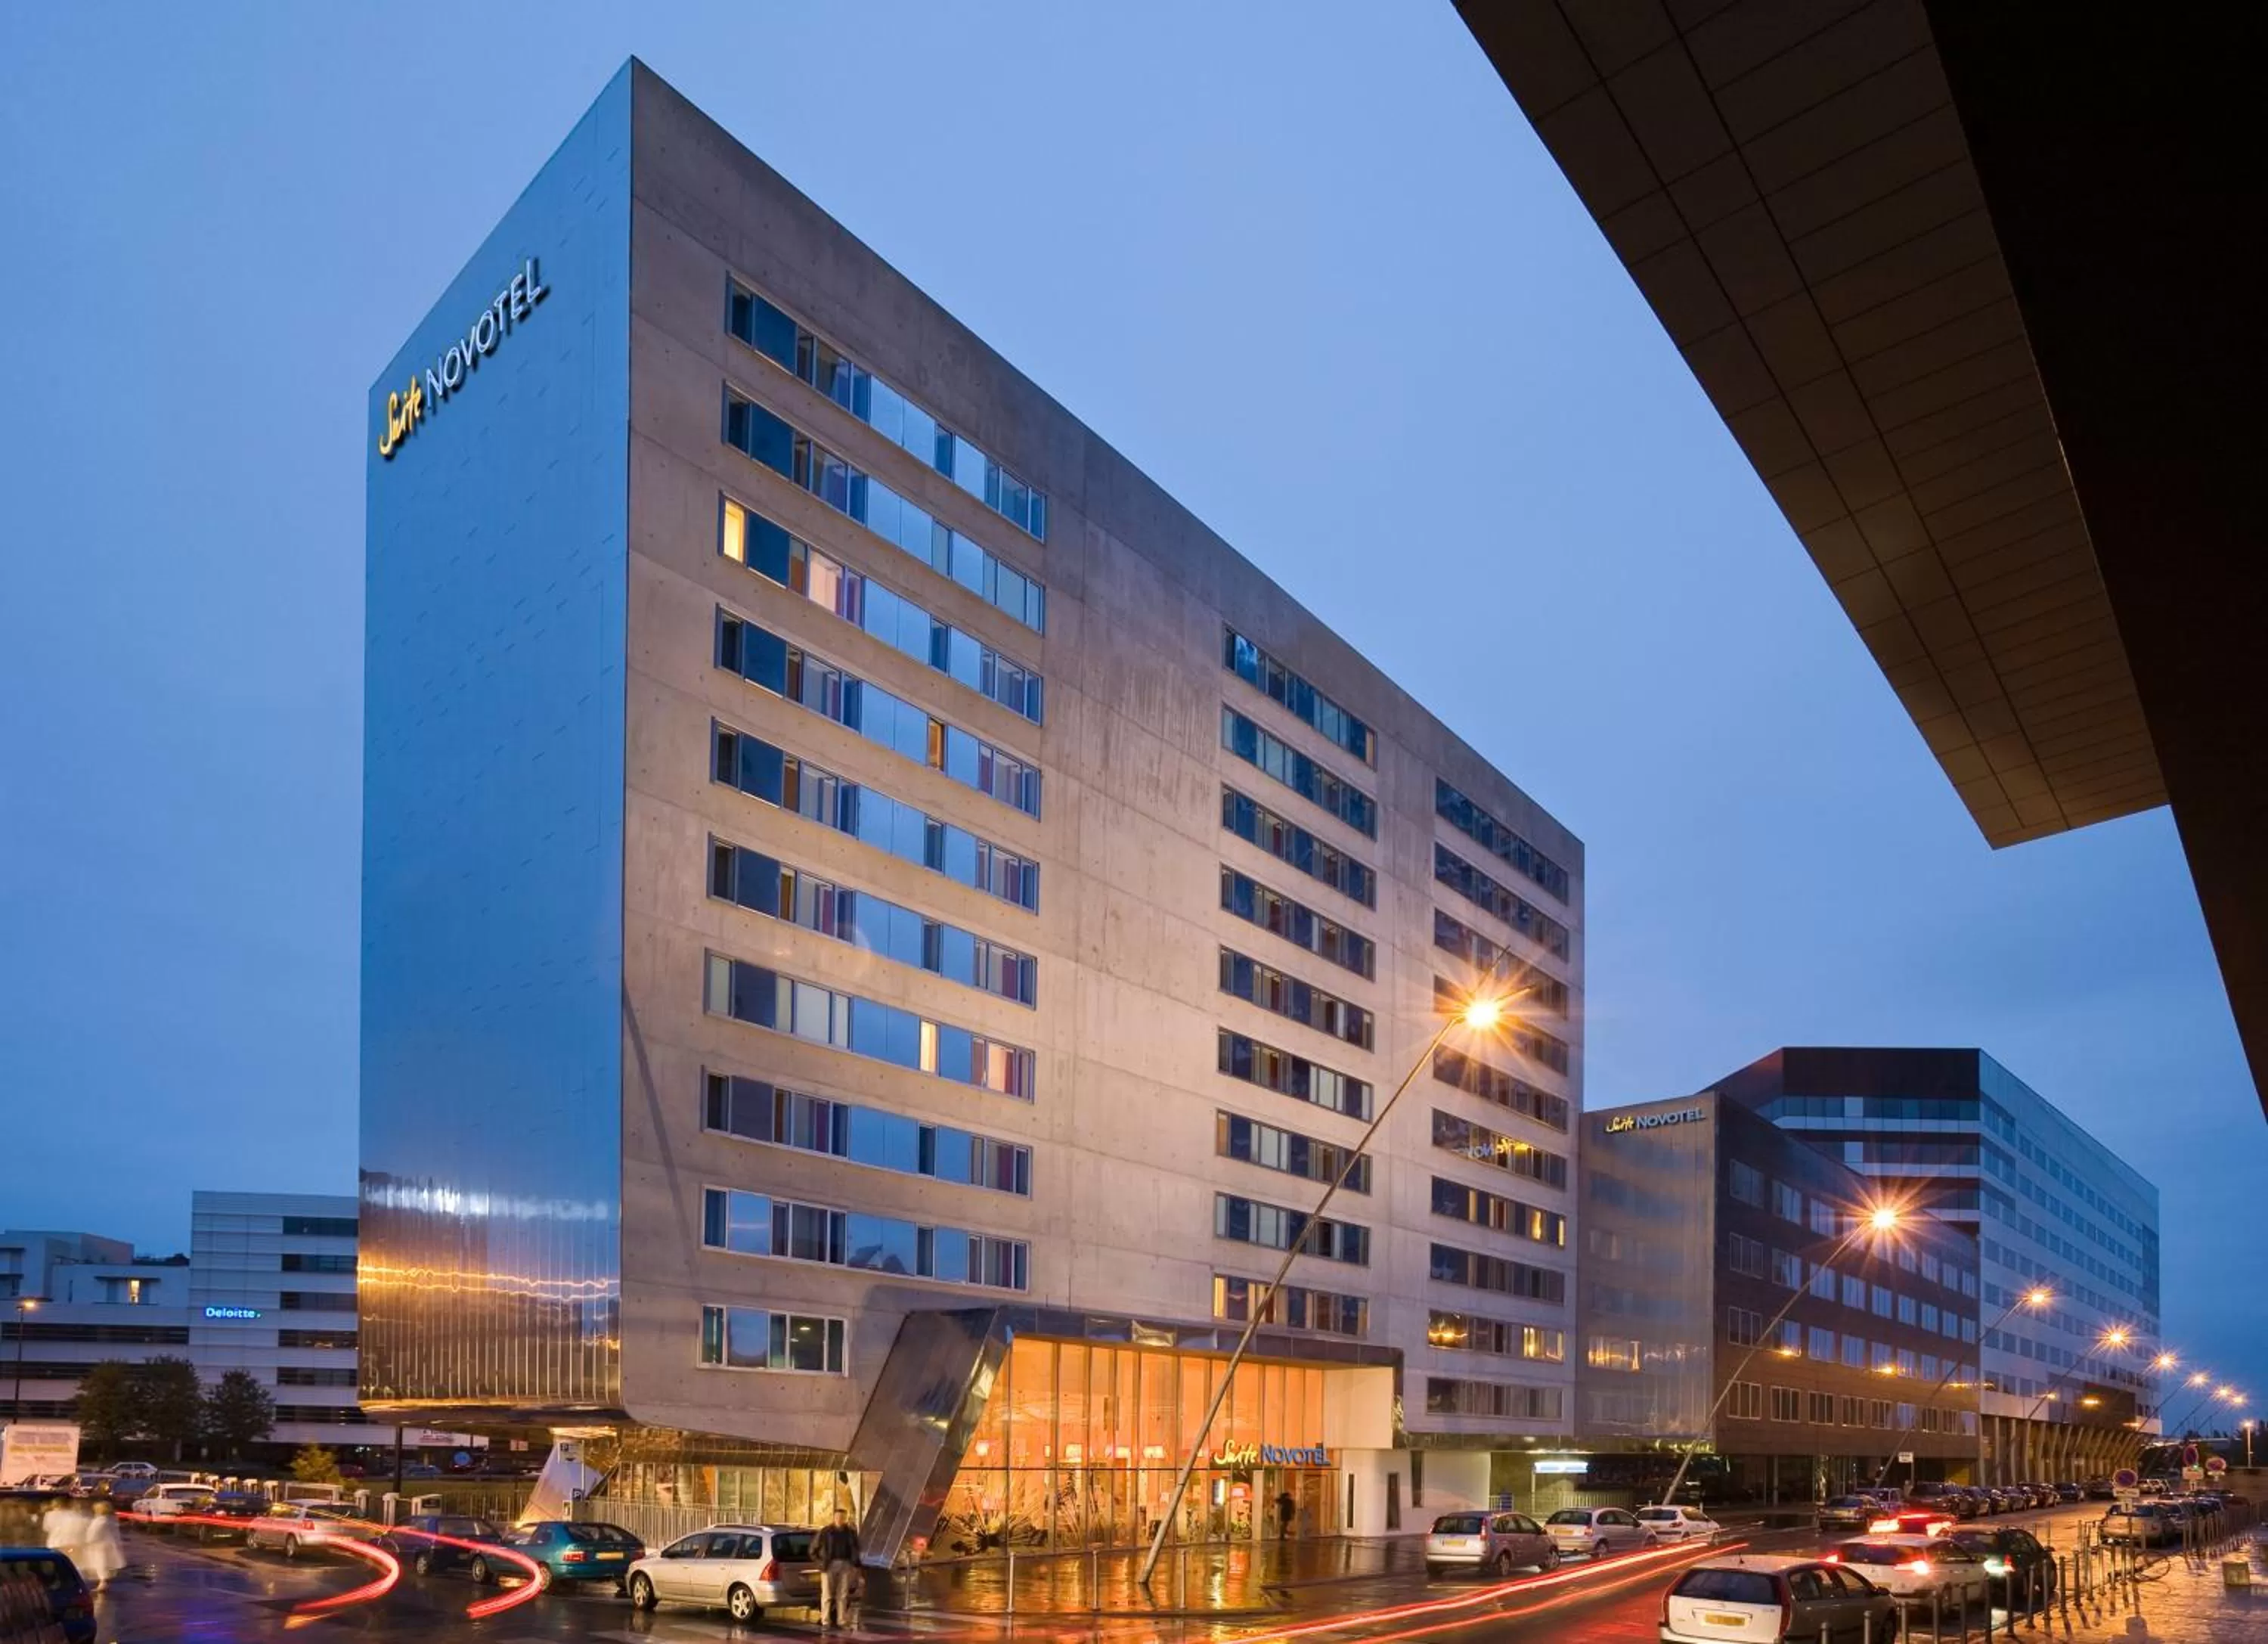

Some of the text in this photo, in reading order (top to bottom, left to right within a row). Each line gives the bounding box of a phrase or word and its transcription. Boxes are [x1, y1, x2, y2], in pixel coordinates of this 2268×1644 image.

[379, 259, 542, 454] Suite NOVOTEL
[1606, 1107, 1704, 1132] Suite NOVOTEL
[1213, 1439, 1331, 1466] Suite NOVOTEL
